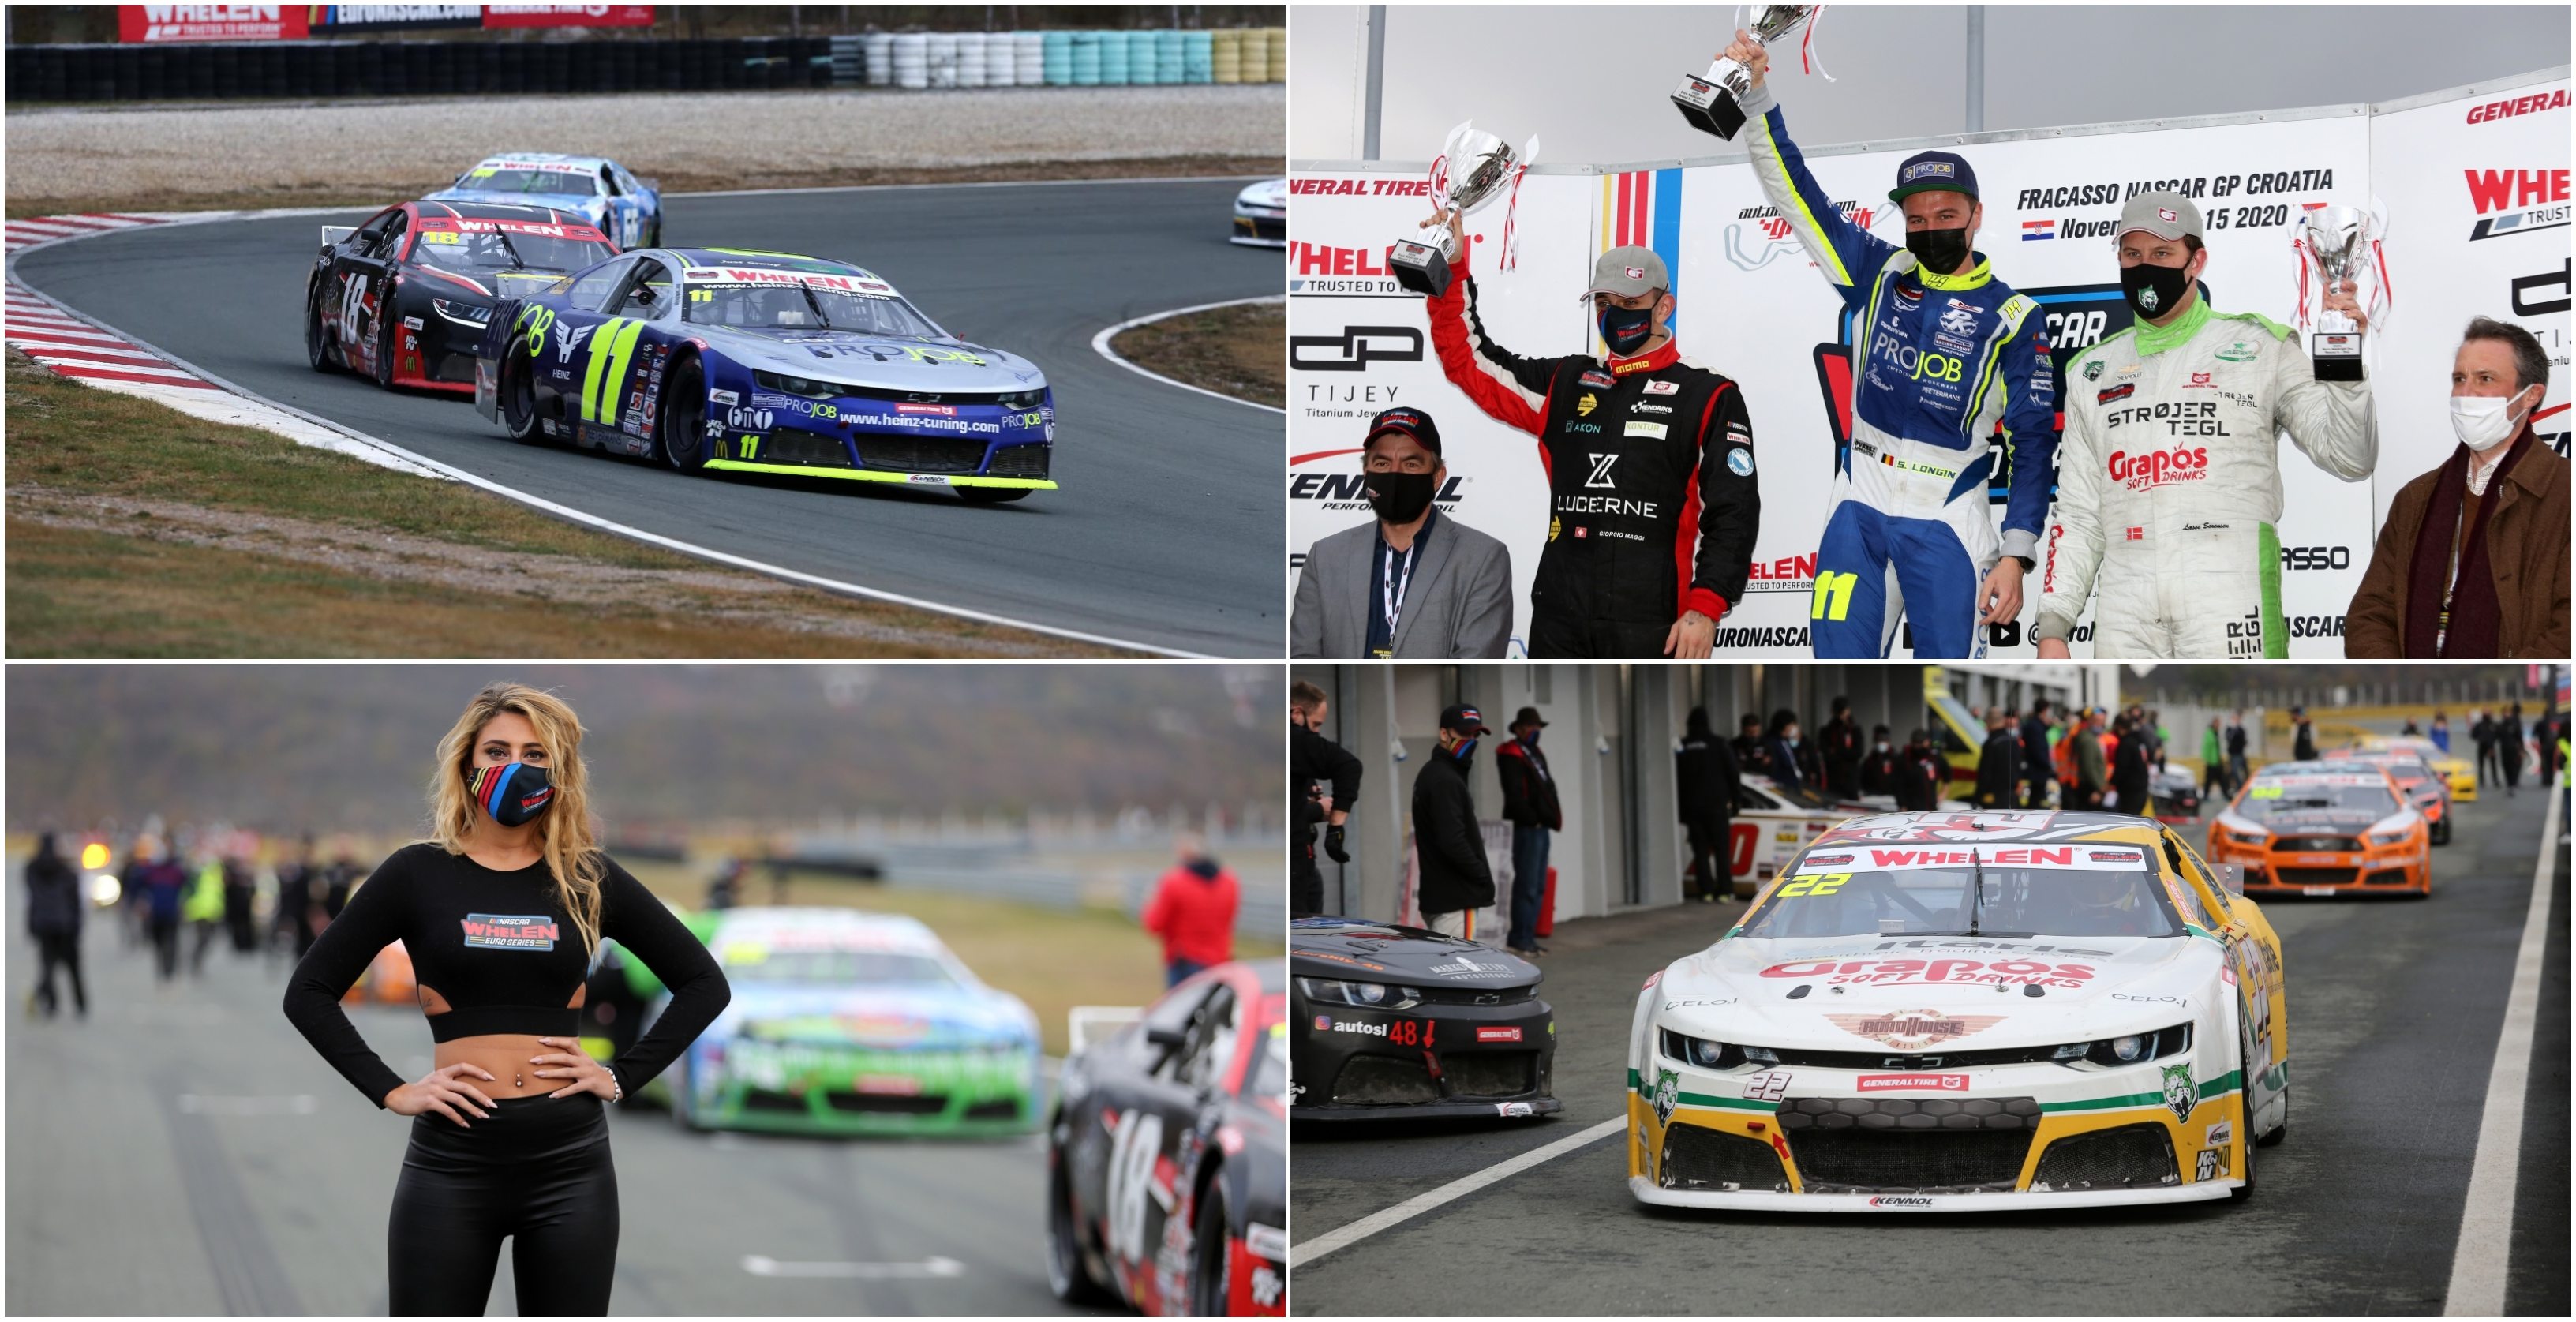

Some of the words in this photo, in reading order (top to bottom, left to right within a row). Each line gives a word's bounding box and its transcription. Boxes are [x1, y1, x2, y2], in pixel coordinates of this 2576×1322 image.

[1915, 163, 1951, 174] PROJOB
[1372, 181, 1430, 197] TIRE
[2018, 184, 2119, 210] FRACASSO
[2212, 175, 2241, 197] GP
[2246, 169, 2333, 194] CROATIA
[2207, 209, 2228, 230] 15
[2236, 204, 2287, 228] 2020
[456, 220, 565, 237] WHELEN
[421, 231, 460, 245] 18
[726, 269, 852, 290] WHELEN
[1309, 280, 1374, 293] TRUSTED
[1378, 281, 1395, 293] TO
[688, 290, 713, 301] 11
[341, 272, 369, 345] 18
[804, 345, 987, 365] PROJOB
[1873, 332, 1963, 382] PROJOB
[552, 369, 571, 380] HEINZ
[581, 316, 646, 427] 11
[1616, 360, 1650, 374] momo
[1308, 384, 1398, 402] TIJEY
[784, 399, 837, 418] PROJOB
[1305, 408, 1353, 417] Titanium
[1639, 403, 1673, 414] HENDRIKS
[2108, 402, 2217, 429] STRØJER
[840, 414, 999, 433] www.heinz-tuning.com
[1002, 413, 1041, 429] PROJOB
[1574, 424, 1601, 433] AKON
[1626, 422, 1660, 432] KONTUR
[2166, 419, 2230, 436] TEGL
[739, 435, 760, 459] 11
[1728, 433, 1750, 444] WHELEN
[1911, 463, 1956, 479] LONGIN
[2126, 476, 2151, 491] SOFT
[2161, 469, 2207, 483] DRINKS
[1558, 496, 1658, 519] LUCERNE
[1624, 533, 1645, 541] MAGGI
[1811, 570, 1858, 621] 11
[1871, 848, 2072, 868] WHELEN
[1777, 873, 1854, 898] 22
[462, 921, 559, 940] WHELEN
[485, 937, 507, 946] EURO
[1758, 957, 2096, 982] Grapos
[1827, 972, 1918, 985] SOFT
[1949, 970, 2082, 988] DRINKS
[1334, 1020, 1387, 1037] autosl
[1389, 1021, 1418, 1047] 48
[1862, 1017, 1964, 1036] ROADHOUSE
[1743, 1071, 1792, 1102] 22
[1862, 1078, 1912, 1088] GENERAL
[1912, 1078, 1939, 1087] TIRE
[2196, 1150, 2218, 1182] K&N
[1874, 1197, 1933, 1205] KENNOL
